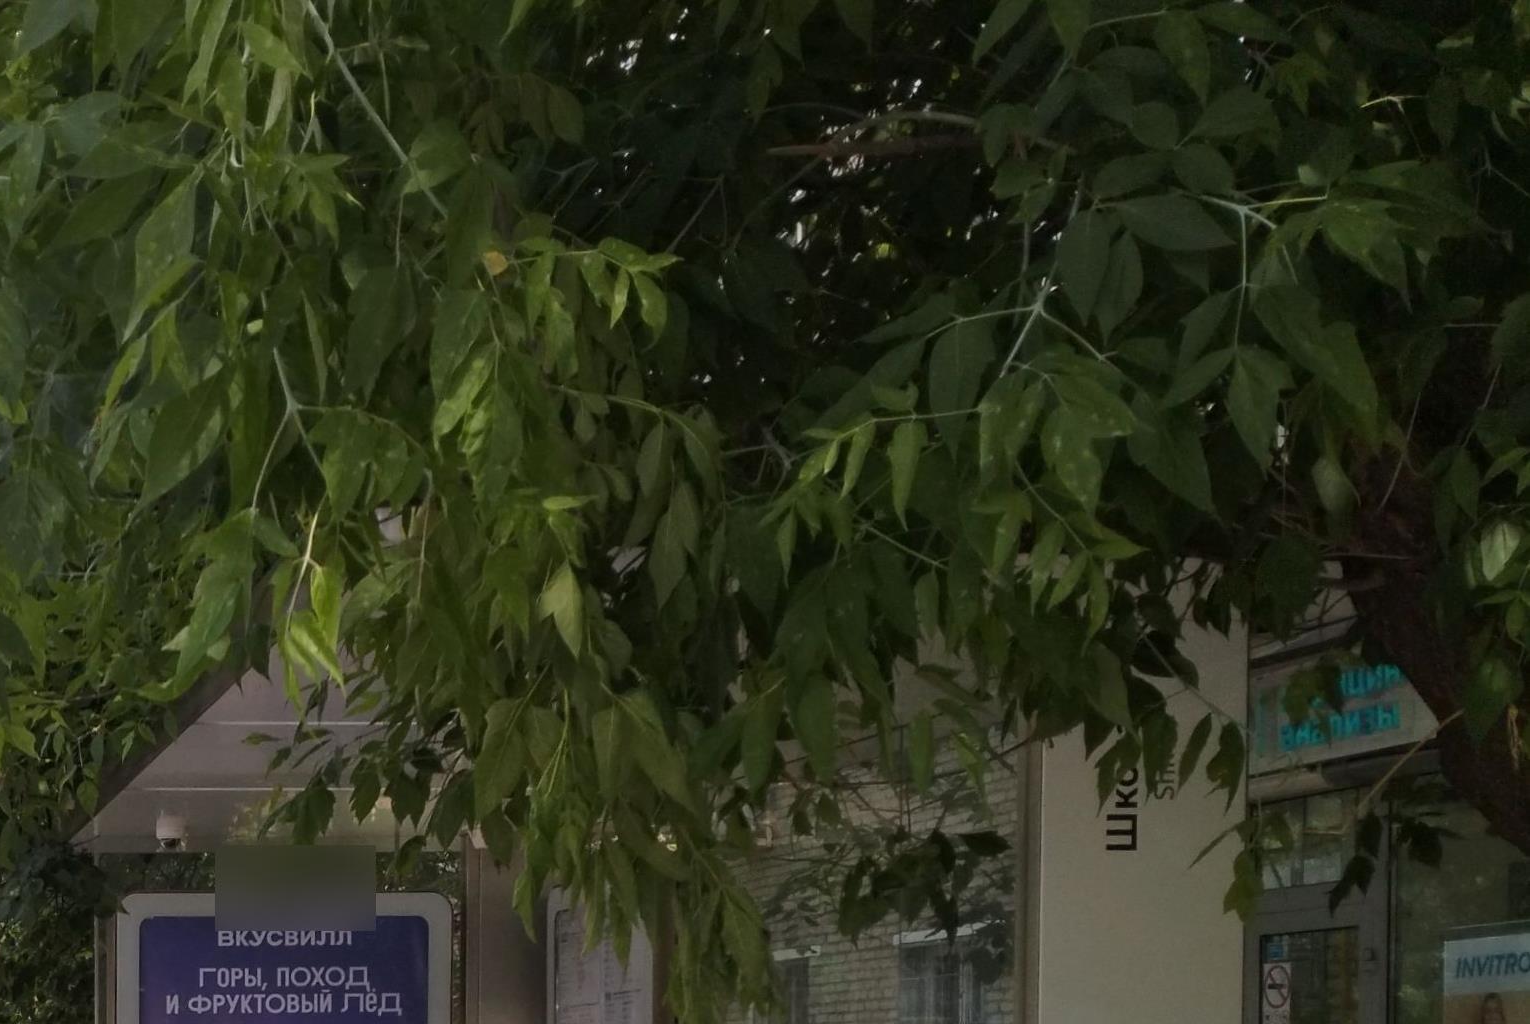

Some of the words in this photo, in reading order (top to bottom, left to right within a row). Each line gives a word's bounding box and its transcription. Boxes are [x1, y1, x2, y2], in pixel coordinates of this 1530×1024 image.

[217, 930, 353, 947] ВКУСВИЛЛ
[1456, 951, 1530, 979] INVITRO
[199, 967, 268, 991] ГОРЫ,
[277, 966, 371, 990] ПОХОД
[165, 994, 180, 1015] И
[187, 989, 333, 1015] ФРУКТОВЫЙ
